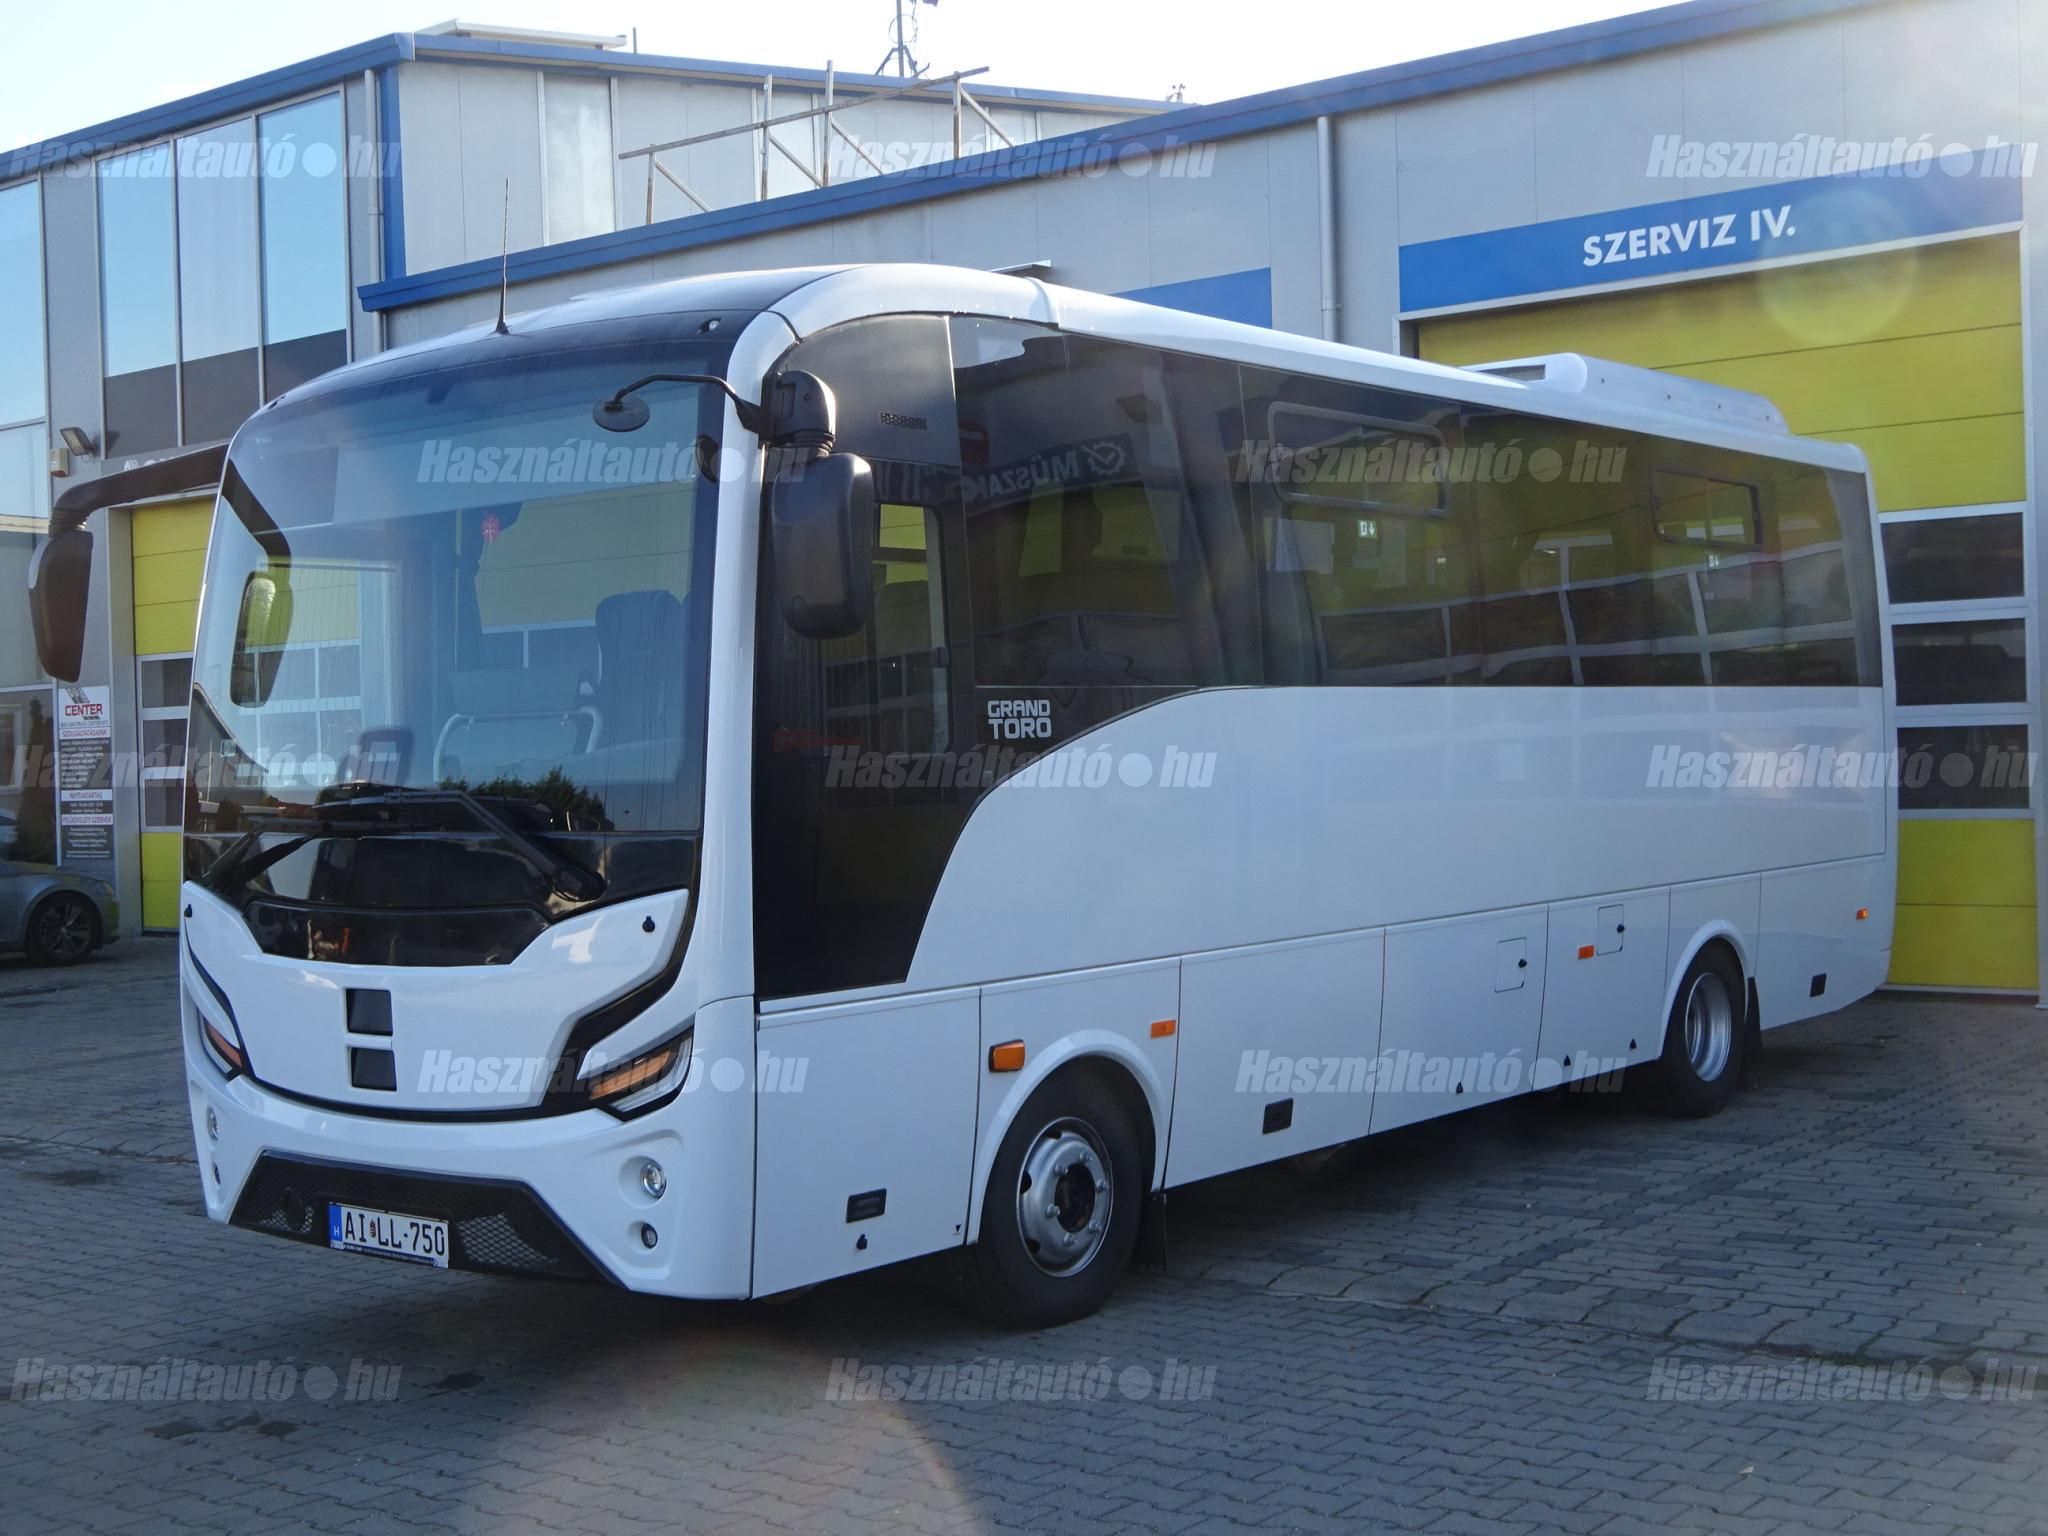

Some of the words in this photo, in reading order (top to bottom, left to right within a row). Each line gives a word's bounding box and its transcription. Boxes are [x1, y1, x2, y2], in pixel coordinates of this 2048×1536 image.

[1582, 213, 1738, 267] SZERVIZ
[1749, 204, 1797, 242] IV.
[64, 703, 104, 717] CENTER
[987, 699, 1051, 718] GRAND
[988, 717, 1053, 740] TORO
[333, 1225, 340, 1237] H
[345, 1210, 368, 1243] AI
